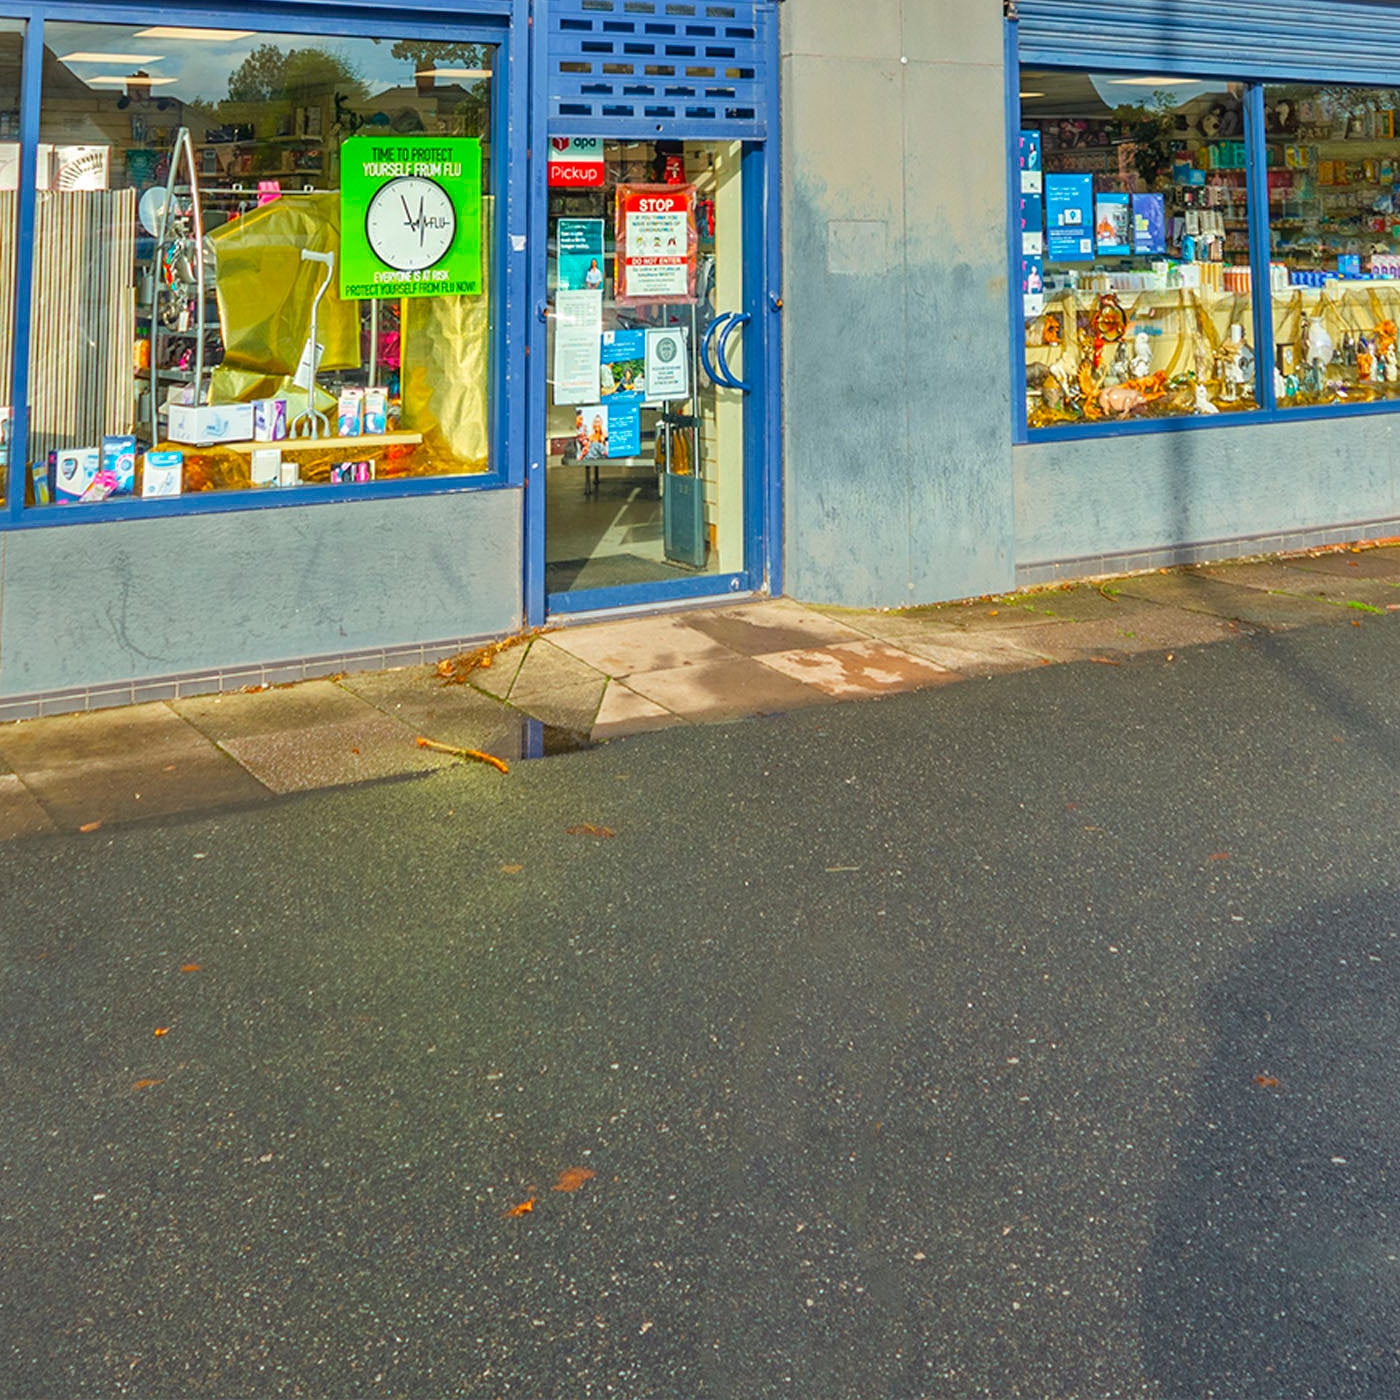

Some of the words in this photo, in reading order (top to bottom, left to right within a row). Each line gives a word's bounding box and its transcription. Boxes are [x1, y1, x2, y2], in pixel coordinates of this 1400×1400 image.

[372, 147, 394, 161] TIME
[397, 147, 409, 161] TO
[412, 147, 453, 161] PROTECT
[362, 162, 412, 176] YOURSELF
[414, 162, 441, 176] FROM
[443, 162, 461, 176] FLU
[551, 166, 598, 182] Pickup
[639, 199, 674, 212] STOP
[430, 217, 446, 229] FLU
[631, 257, 642, 265] DO
[644, 257, 657, 265] NOT
[374, 271, 411, 284] EVERYONE
[414, 270, 421, 281] IS
[422, 270, 431, 281] AT
[432, 270, 449, 281] RISK
[345, 284, 378, 296] PROTECT
[380, 283, 417, 295] YOURSELF
[419, 282, 439, 293] FROM
[441, 281, 455, 293] FLU
